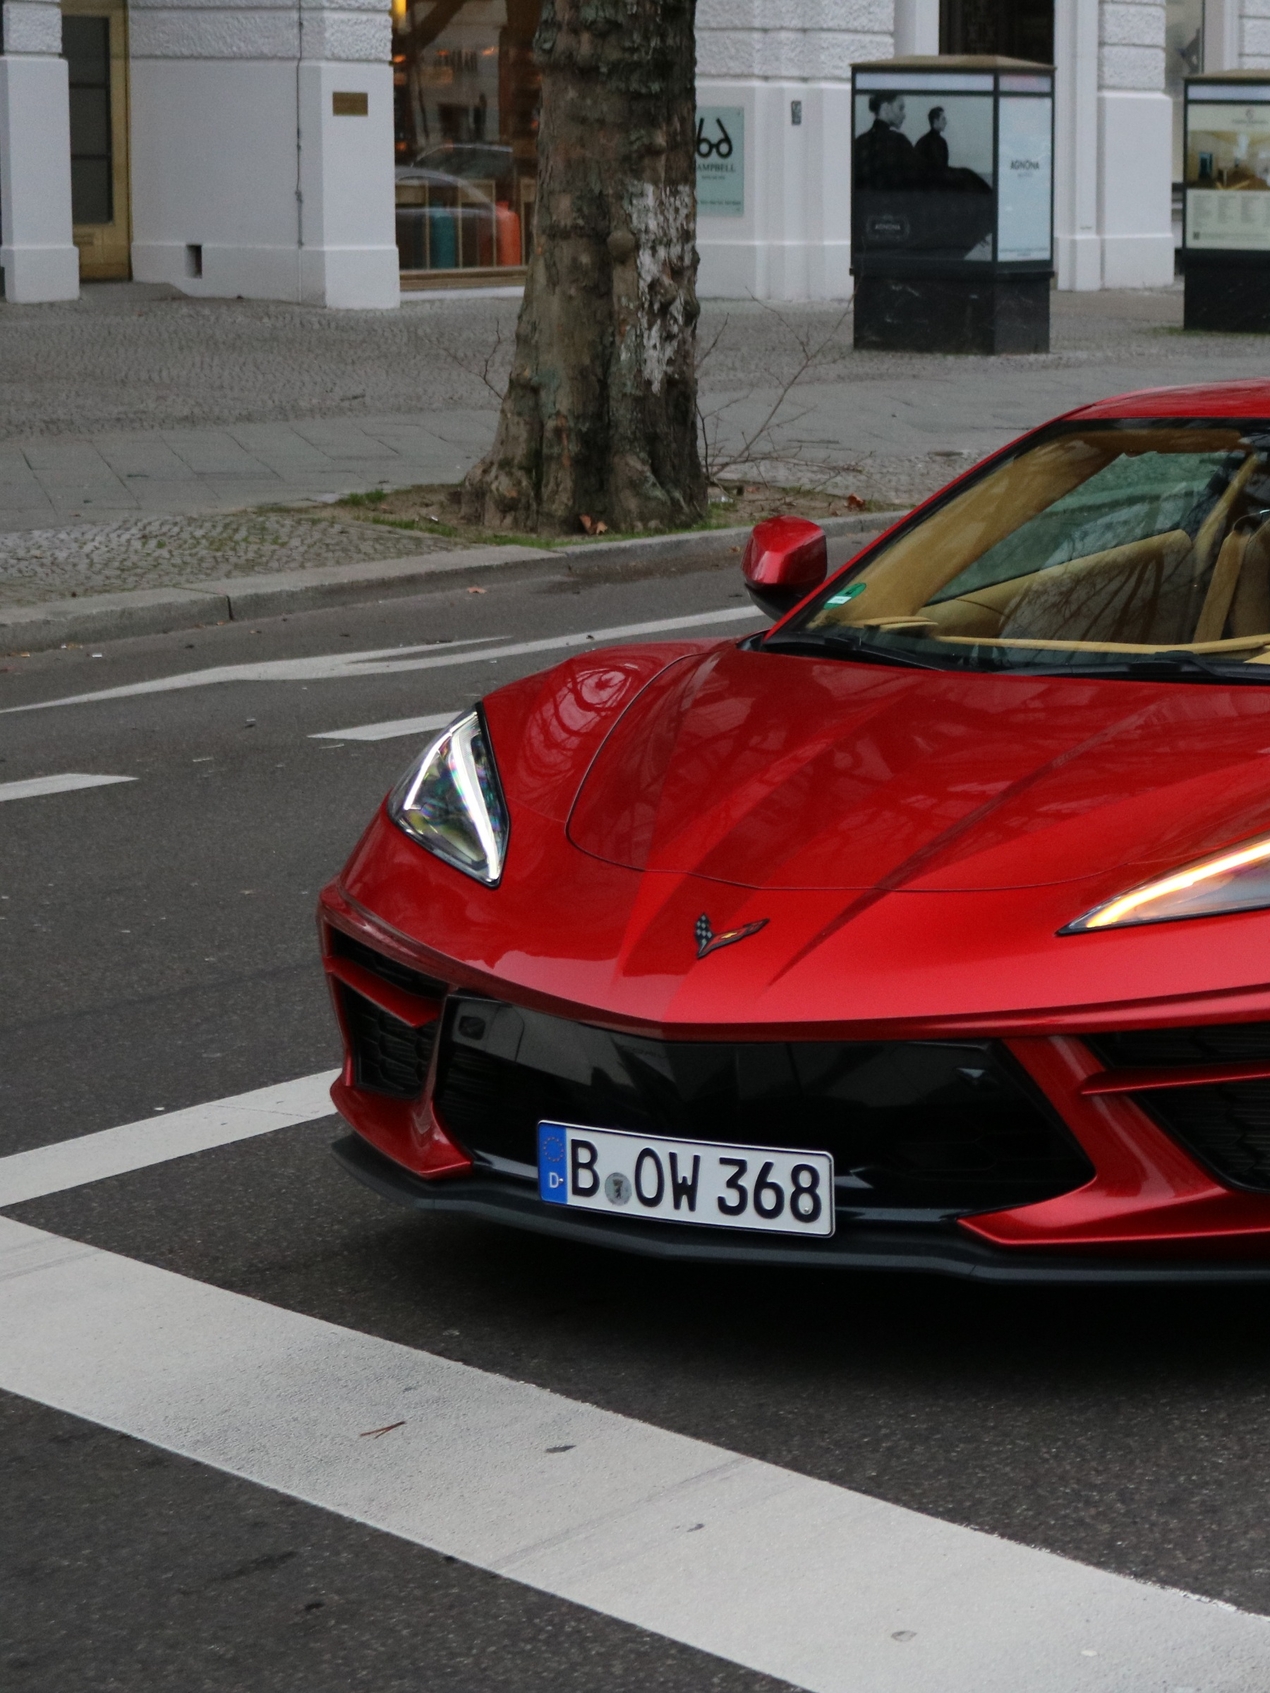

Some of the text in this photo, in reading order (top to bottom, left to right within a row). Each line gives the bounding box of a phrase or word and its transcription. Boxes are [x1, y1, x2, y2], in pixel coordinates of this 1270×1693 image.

[570, 1138, 822, 1224] B OW 368
